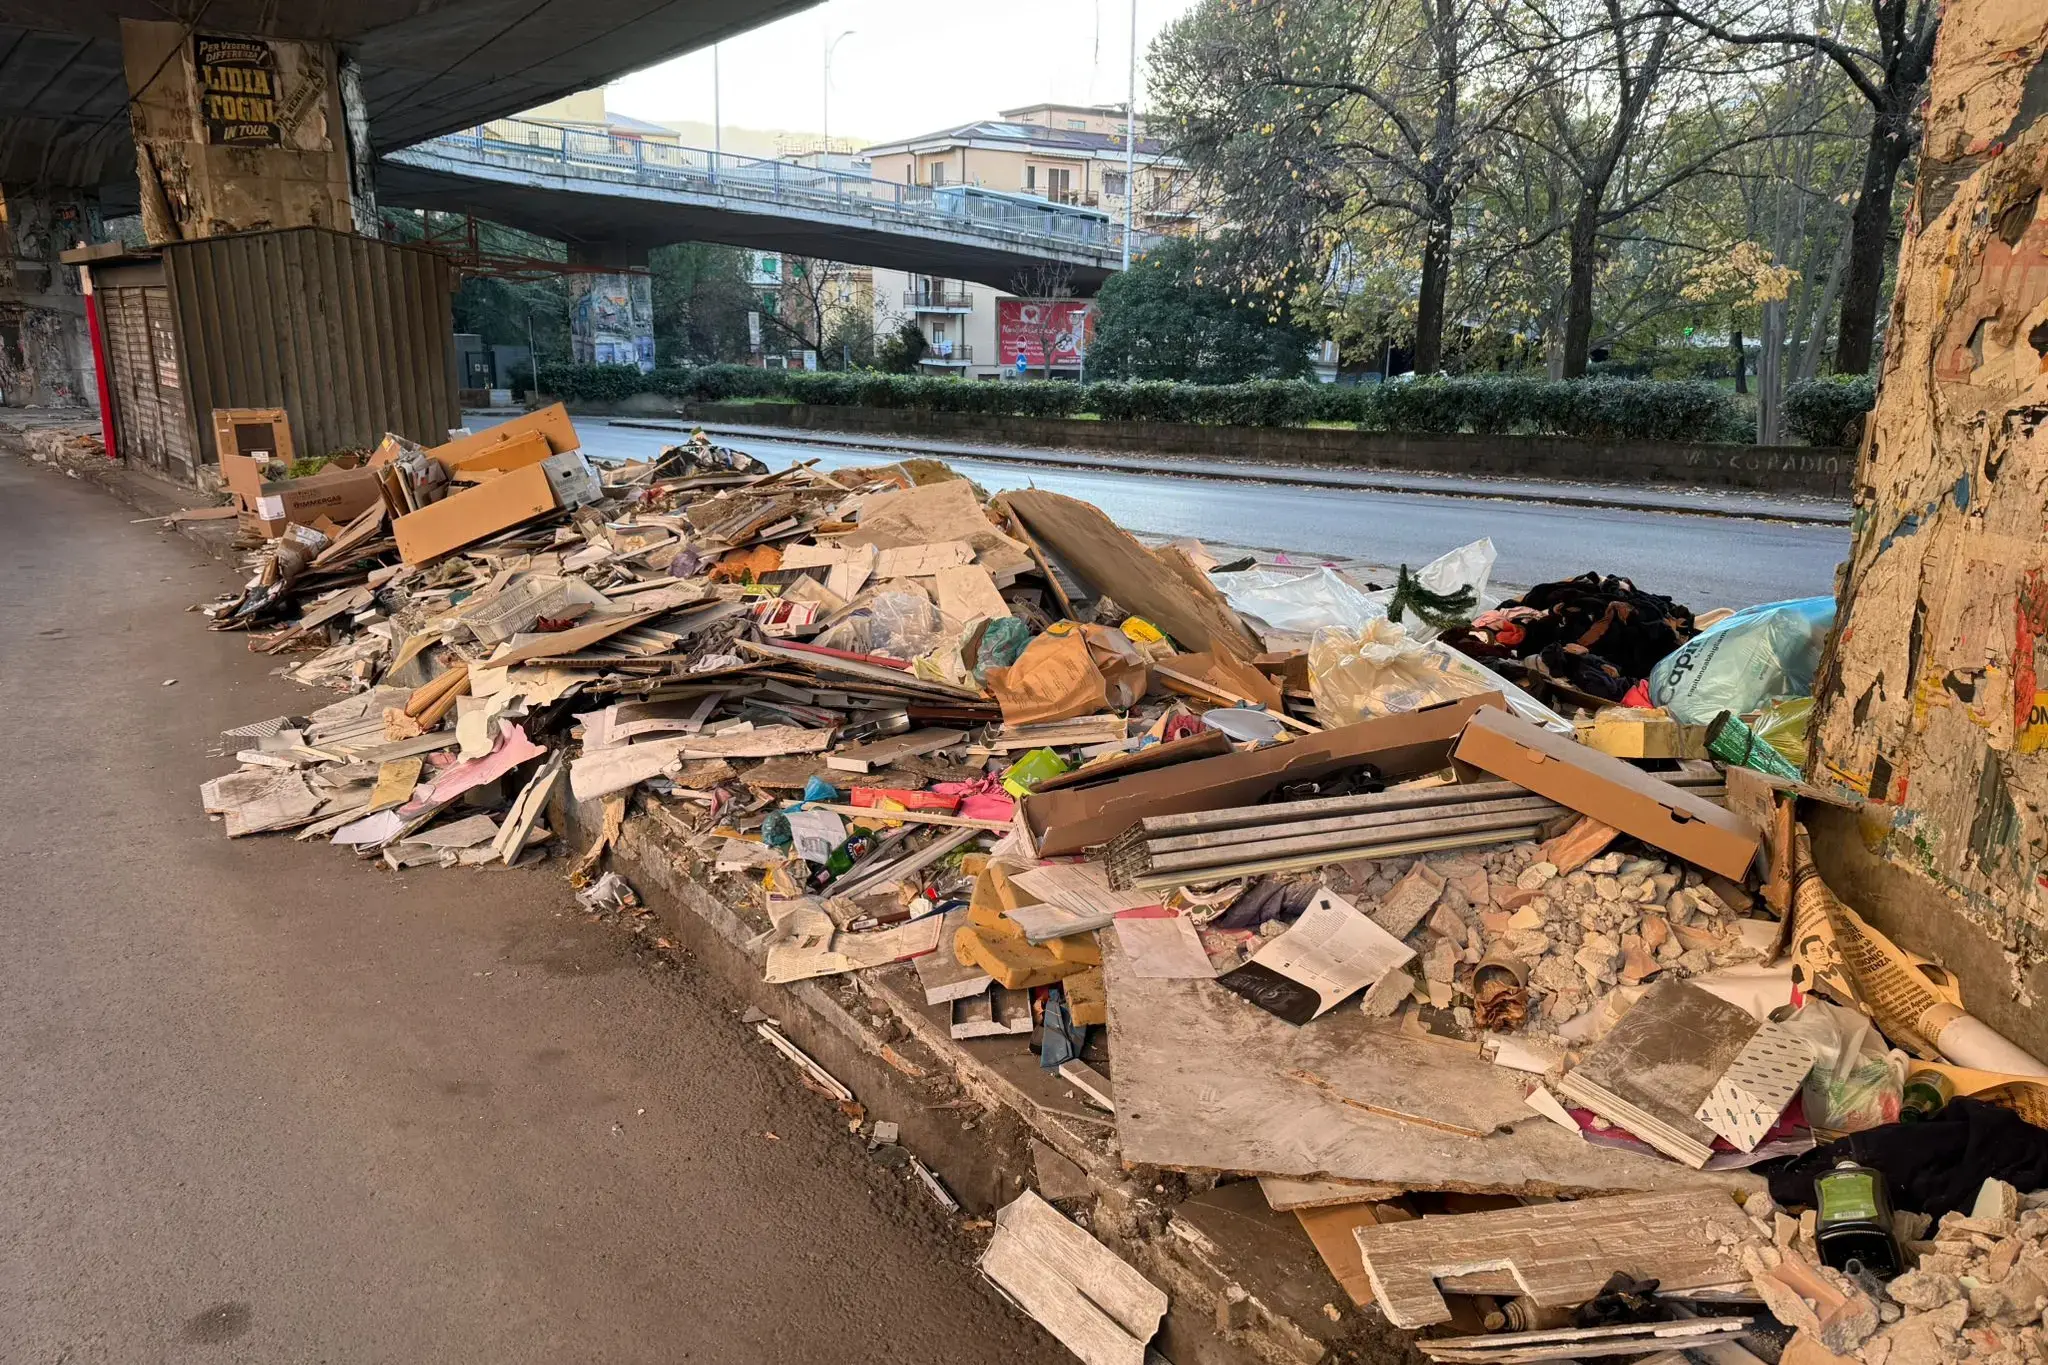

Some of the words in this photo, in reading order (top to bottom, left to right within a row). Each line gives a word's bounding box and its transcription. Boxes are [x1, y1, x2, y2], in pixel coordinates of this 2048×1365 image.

[200, 41, 219, 55] PER
[202, 65, 271, 95] LIDIA
[208, 95, 274, 122] TOGNI
[224, 126, 237, 140] IN
[239, 125, 269, 136] TOUR
